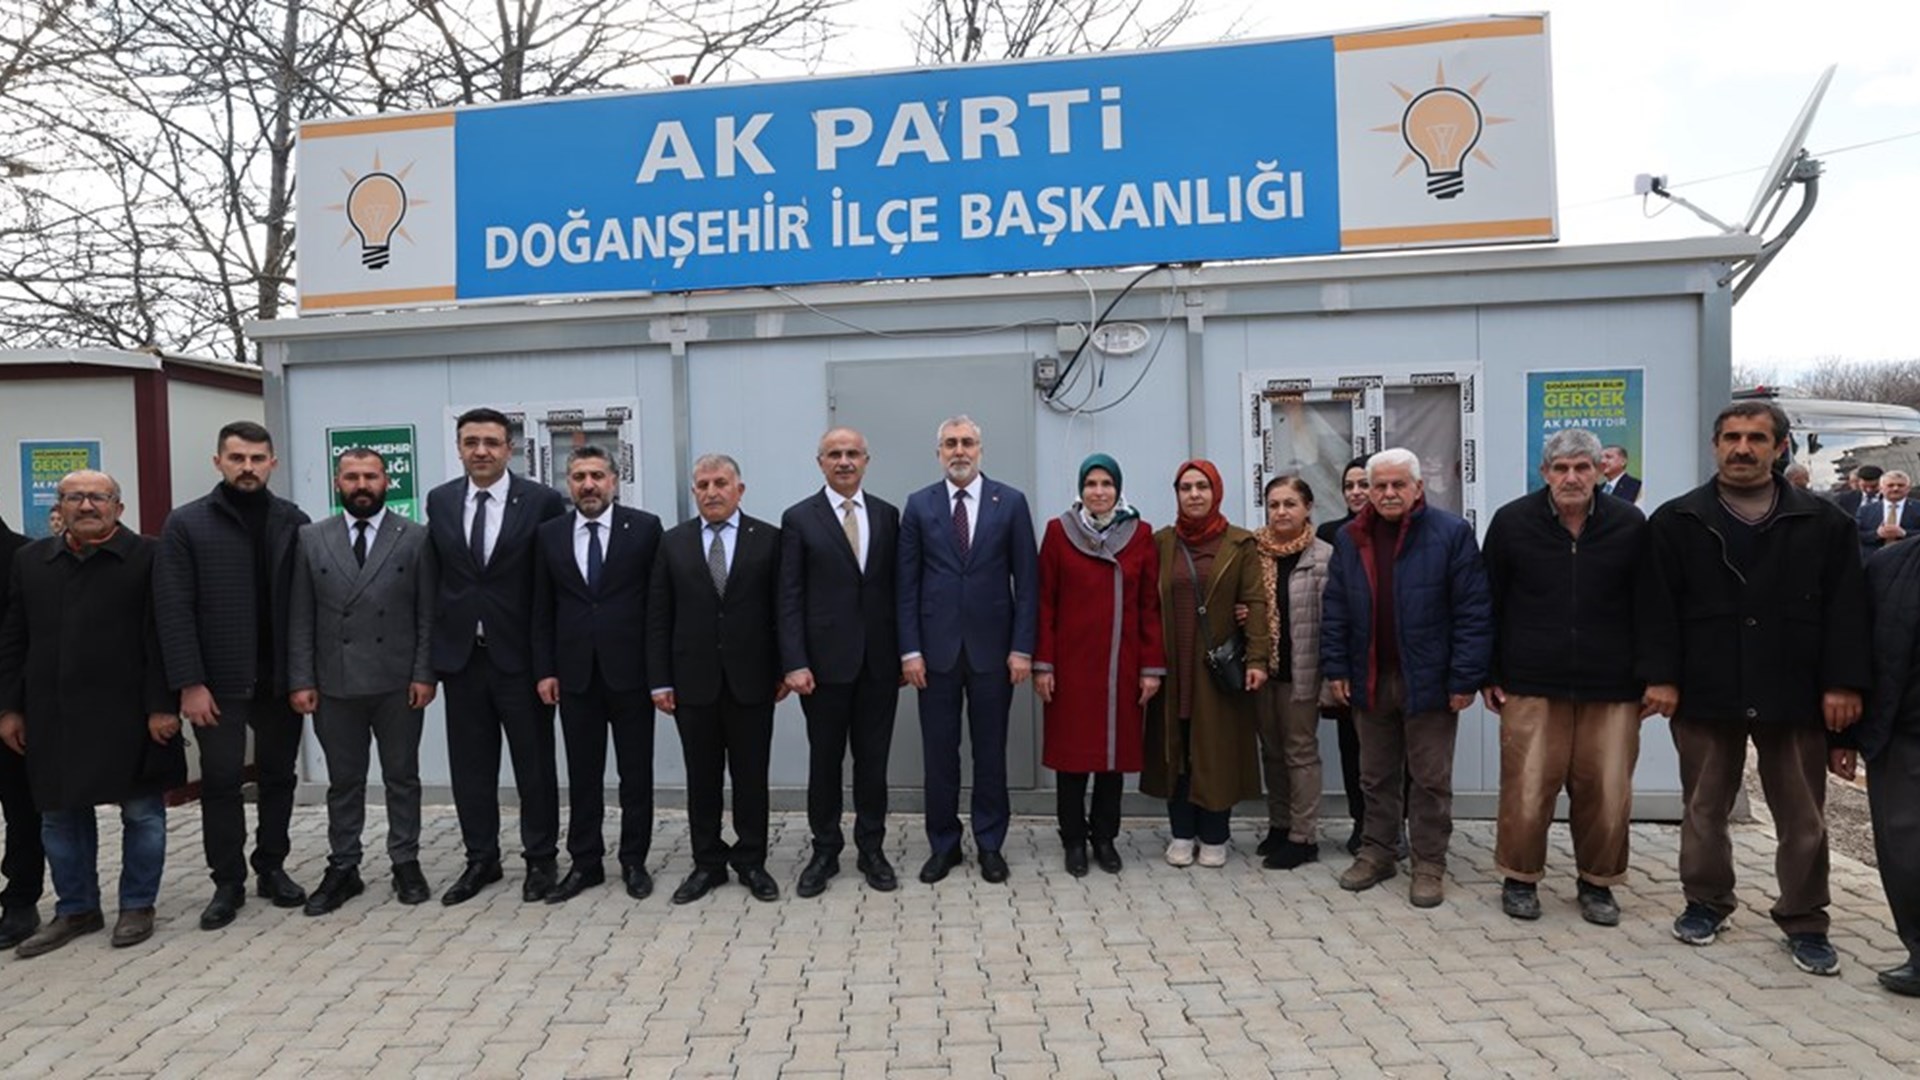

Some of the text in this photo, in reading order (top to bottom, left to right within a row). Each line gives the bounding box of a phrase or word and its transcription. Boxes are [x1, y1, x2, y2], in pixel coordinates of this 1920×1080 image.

[635, 112, 776, 184] AK
[484, 159, 1305, 270] DOĞANŞEHİR İLÇE BAŞKANLIĞI
[1544, 391, 1625, 408] GERÇEK
[1544, 419, 1561, 429] AK
